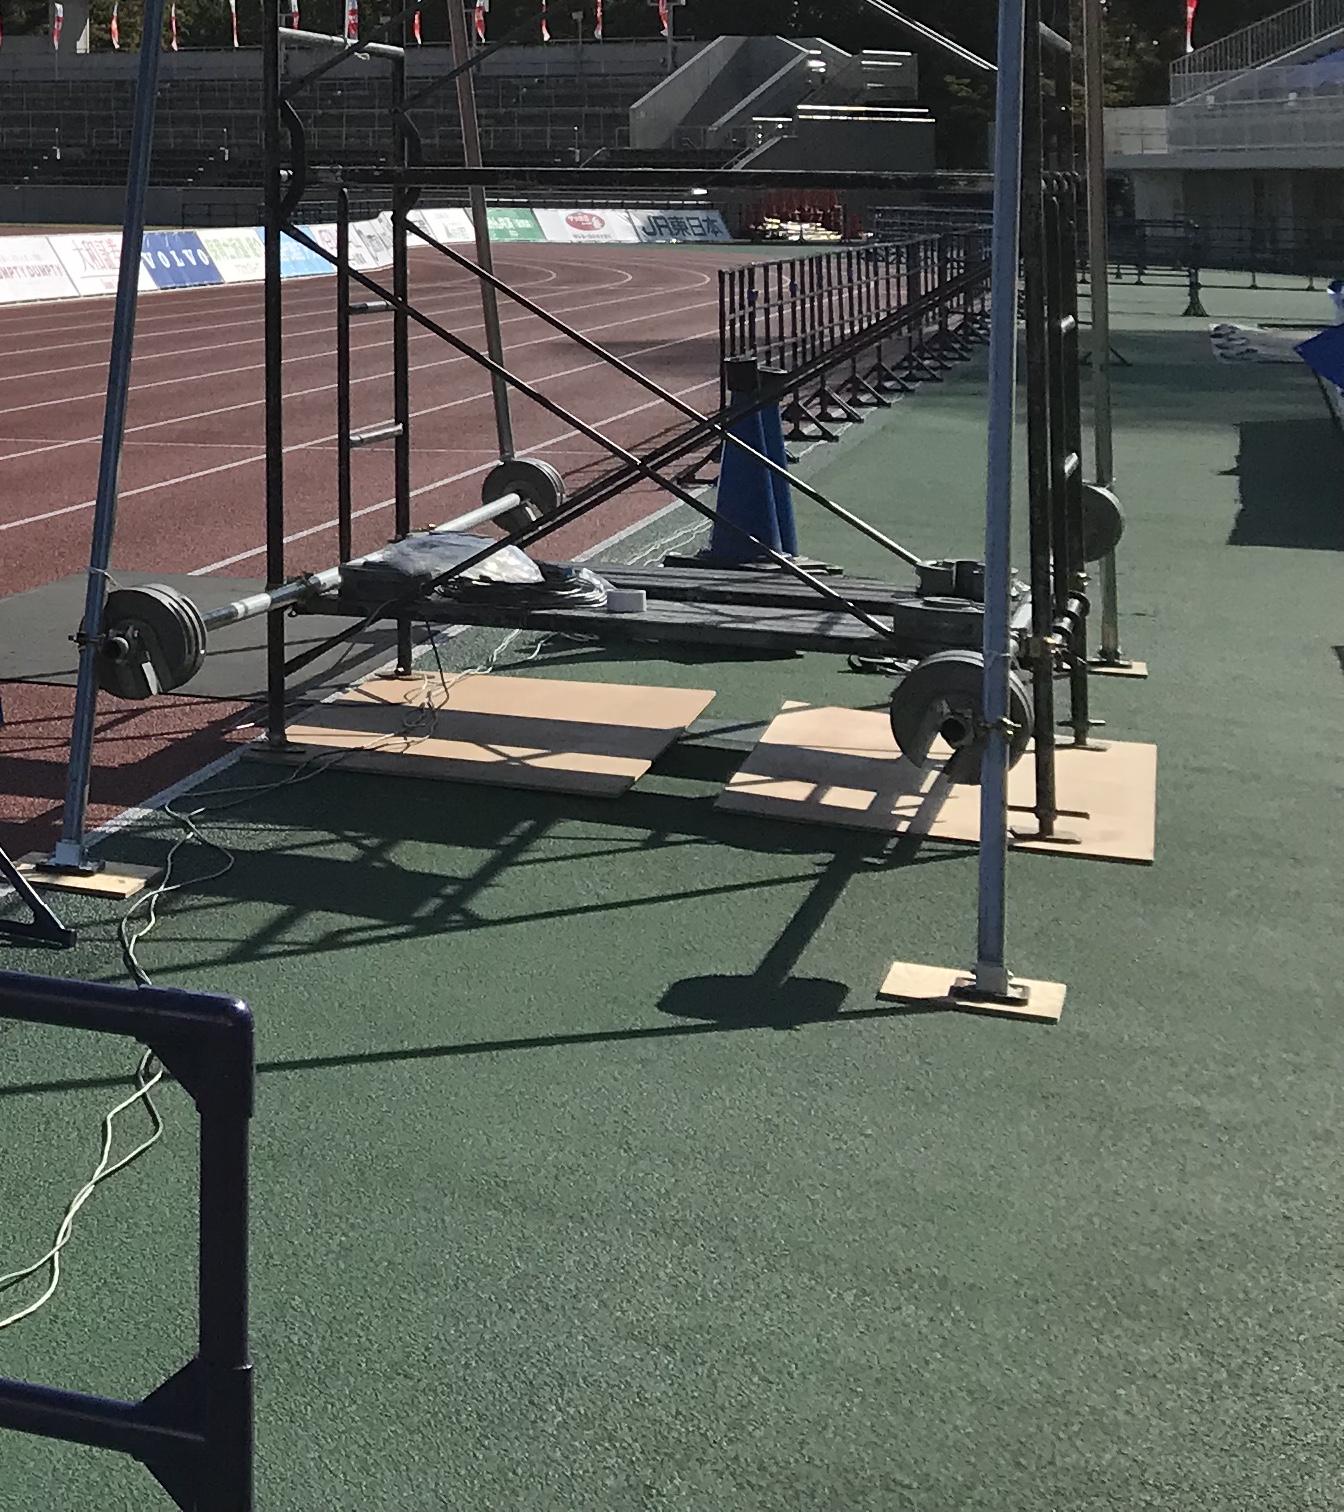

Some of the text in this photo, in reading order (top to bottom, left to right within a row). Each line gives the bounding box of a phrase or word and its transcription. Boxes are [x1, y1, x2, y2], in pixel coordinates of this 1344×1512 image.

[642, 215, 723, 237] JR東日本
[141, 248, 210, 269] VOLVO
